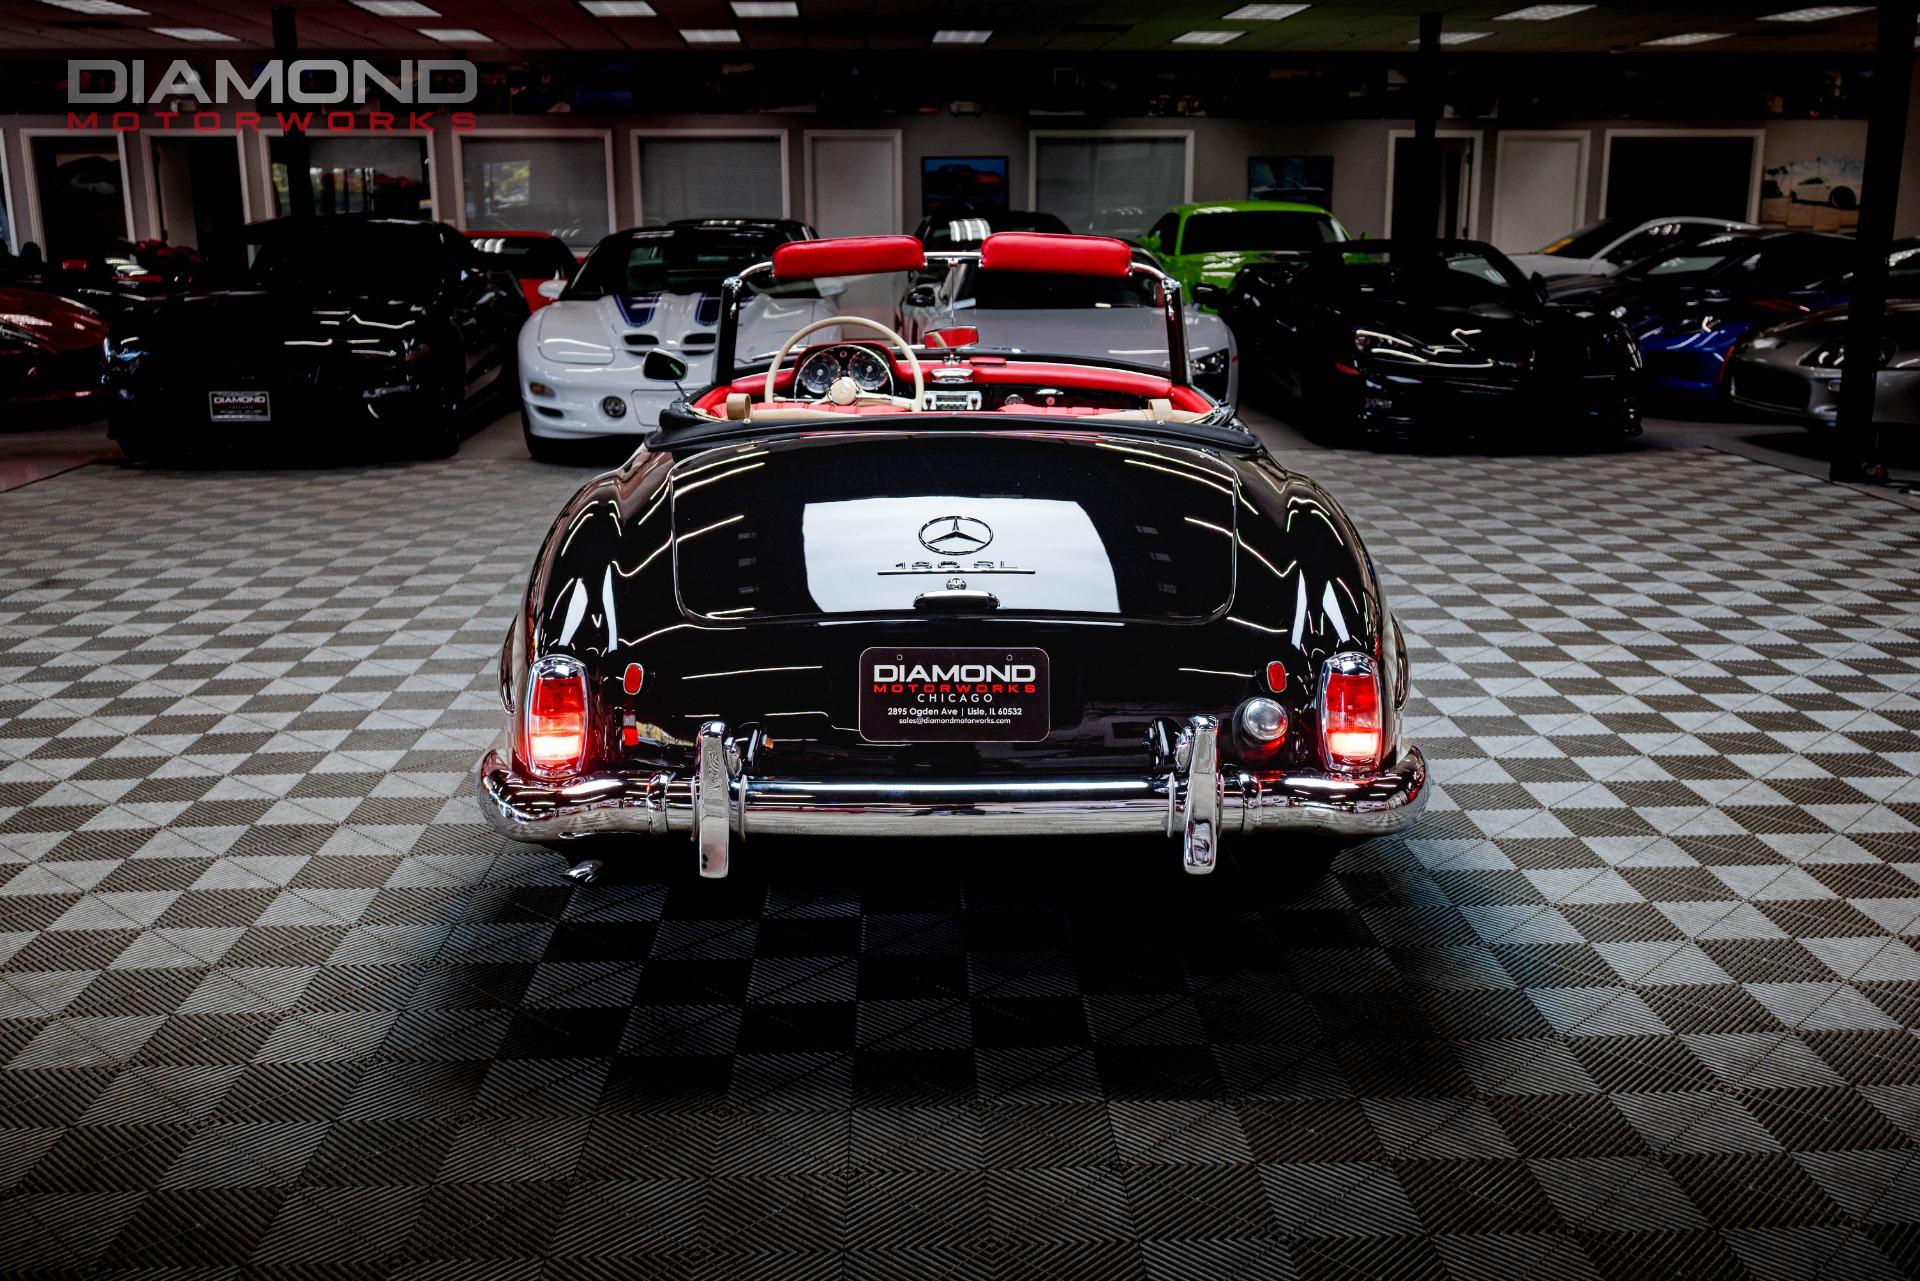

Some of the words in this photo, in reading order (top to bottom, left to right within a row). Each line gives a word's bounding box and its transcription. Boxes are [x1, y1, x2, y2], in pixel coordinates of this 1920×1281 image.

[873, 664, 1036, 683] DIAMOND
[873, 684, 1036, 693] MOTORWORKS
[917, 693, 993, 703] CHICAGO
[909, 708, 939, 717] Ogden
[967, 708, 987, 716] Lisle,
